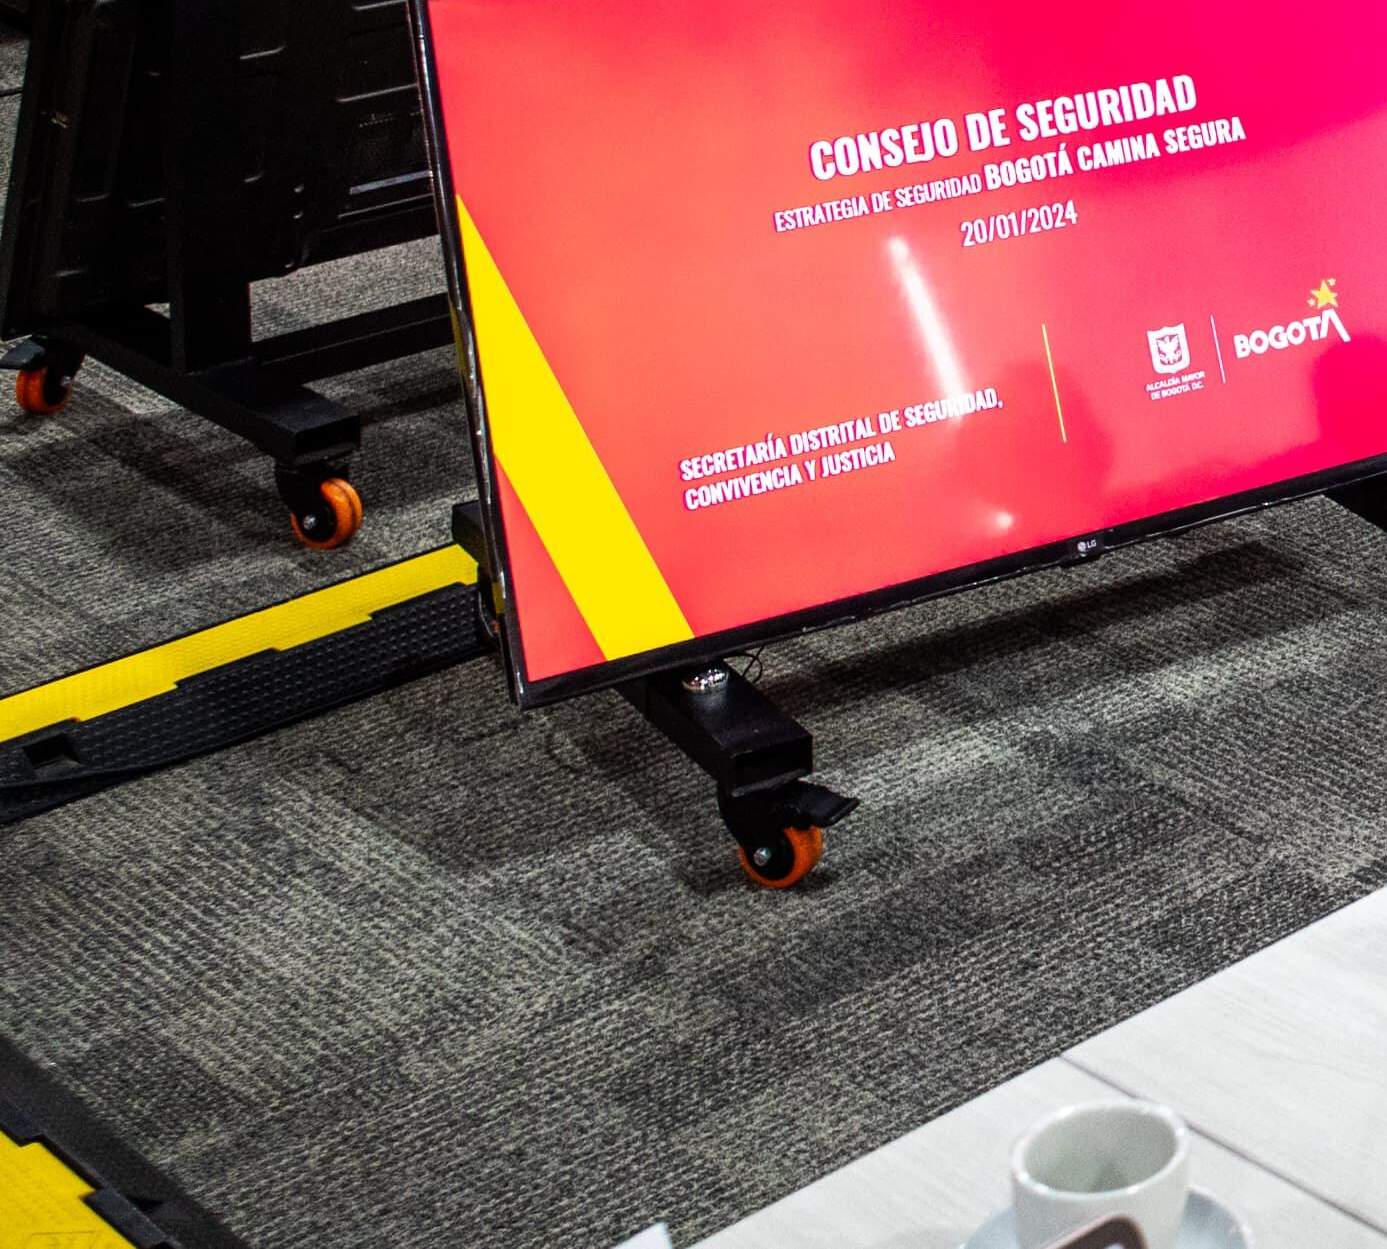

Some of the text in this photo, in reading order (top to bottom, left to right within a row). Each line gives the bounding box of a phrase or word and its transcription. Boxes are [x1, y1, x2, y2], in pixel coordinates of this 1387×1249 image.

[810, 73, 1197, 181] CONSEJO DE SEGURIDAD
[774, 116, 1246, 233] ESTRATEGIA DE SEGURIDAD BOGOTÁ CAMINA SEGURA
[960, 200, 1078, 246] 20/01/2024
[1150, 391, 1161, 400] DE
[1181, 371, 1206, 383] MAYOR
[680, 387, 1004, 481] SECRETARÍA DISTRITAL DE SEGURIDAD,
[684, 441, 895, 510] CONVIVENCIA Y JUSTICIA
